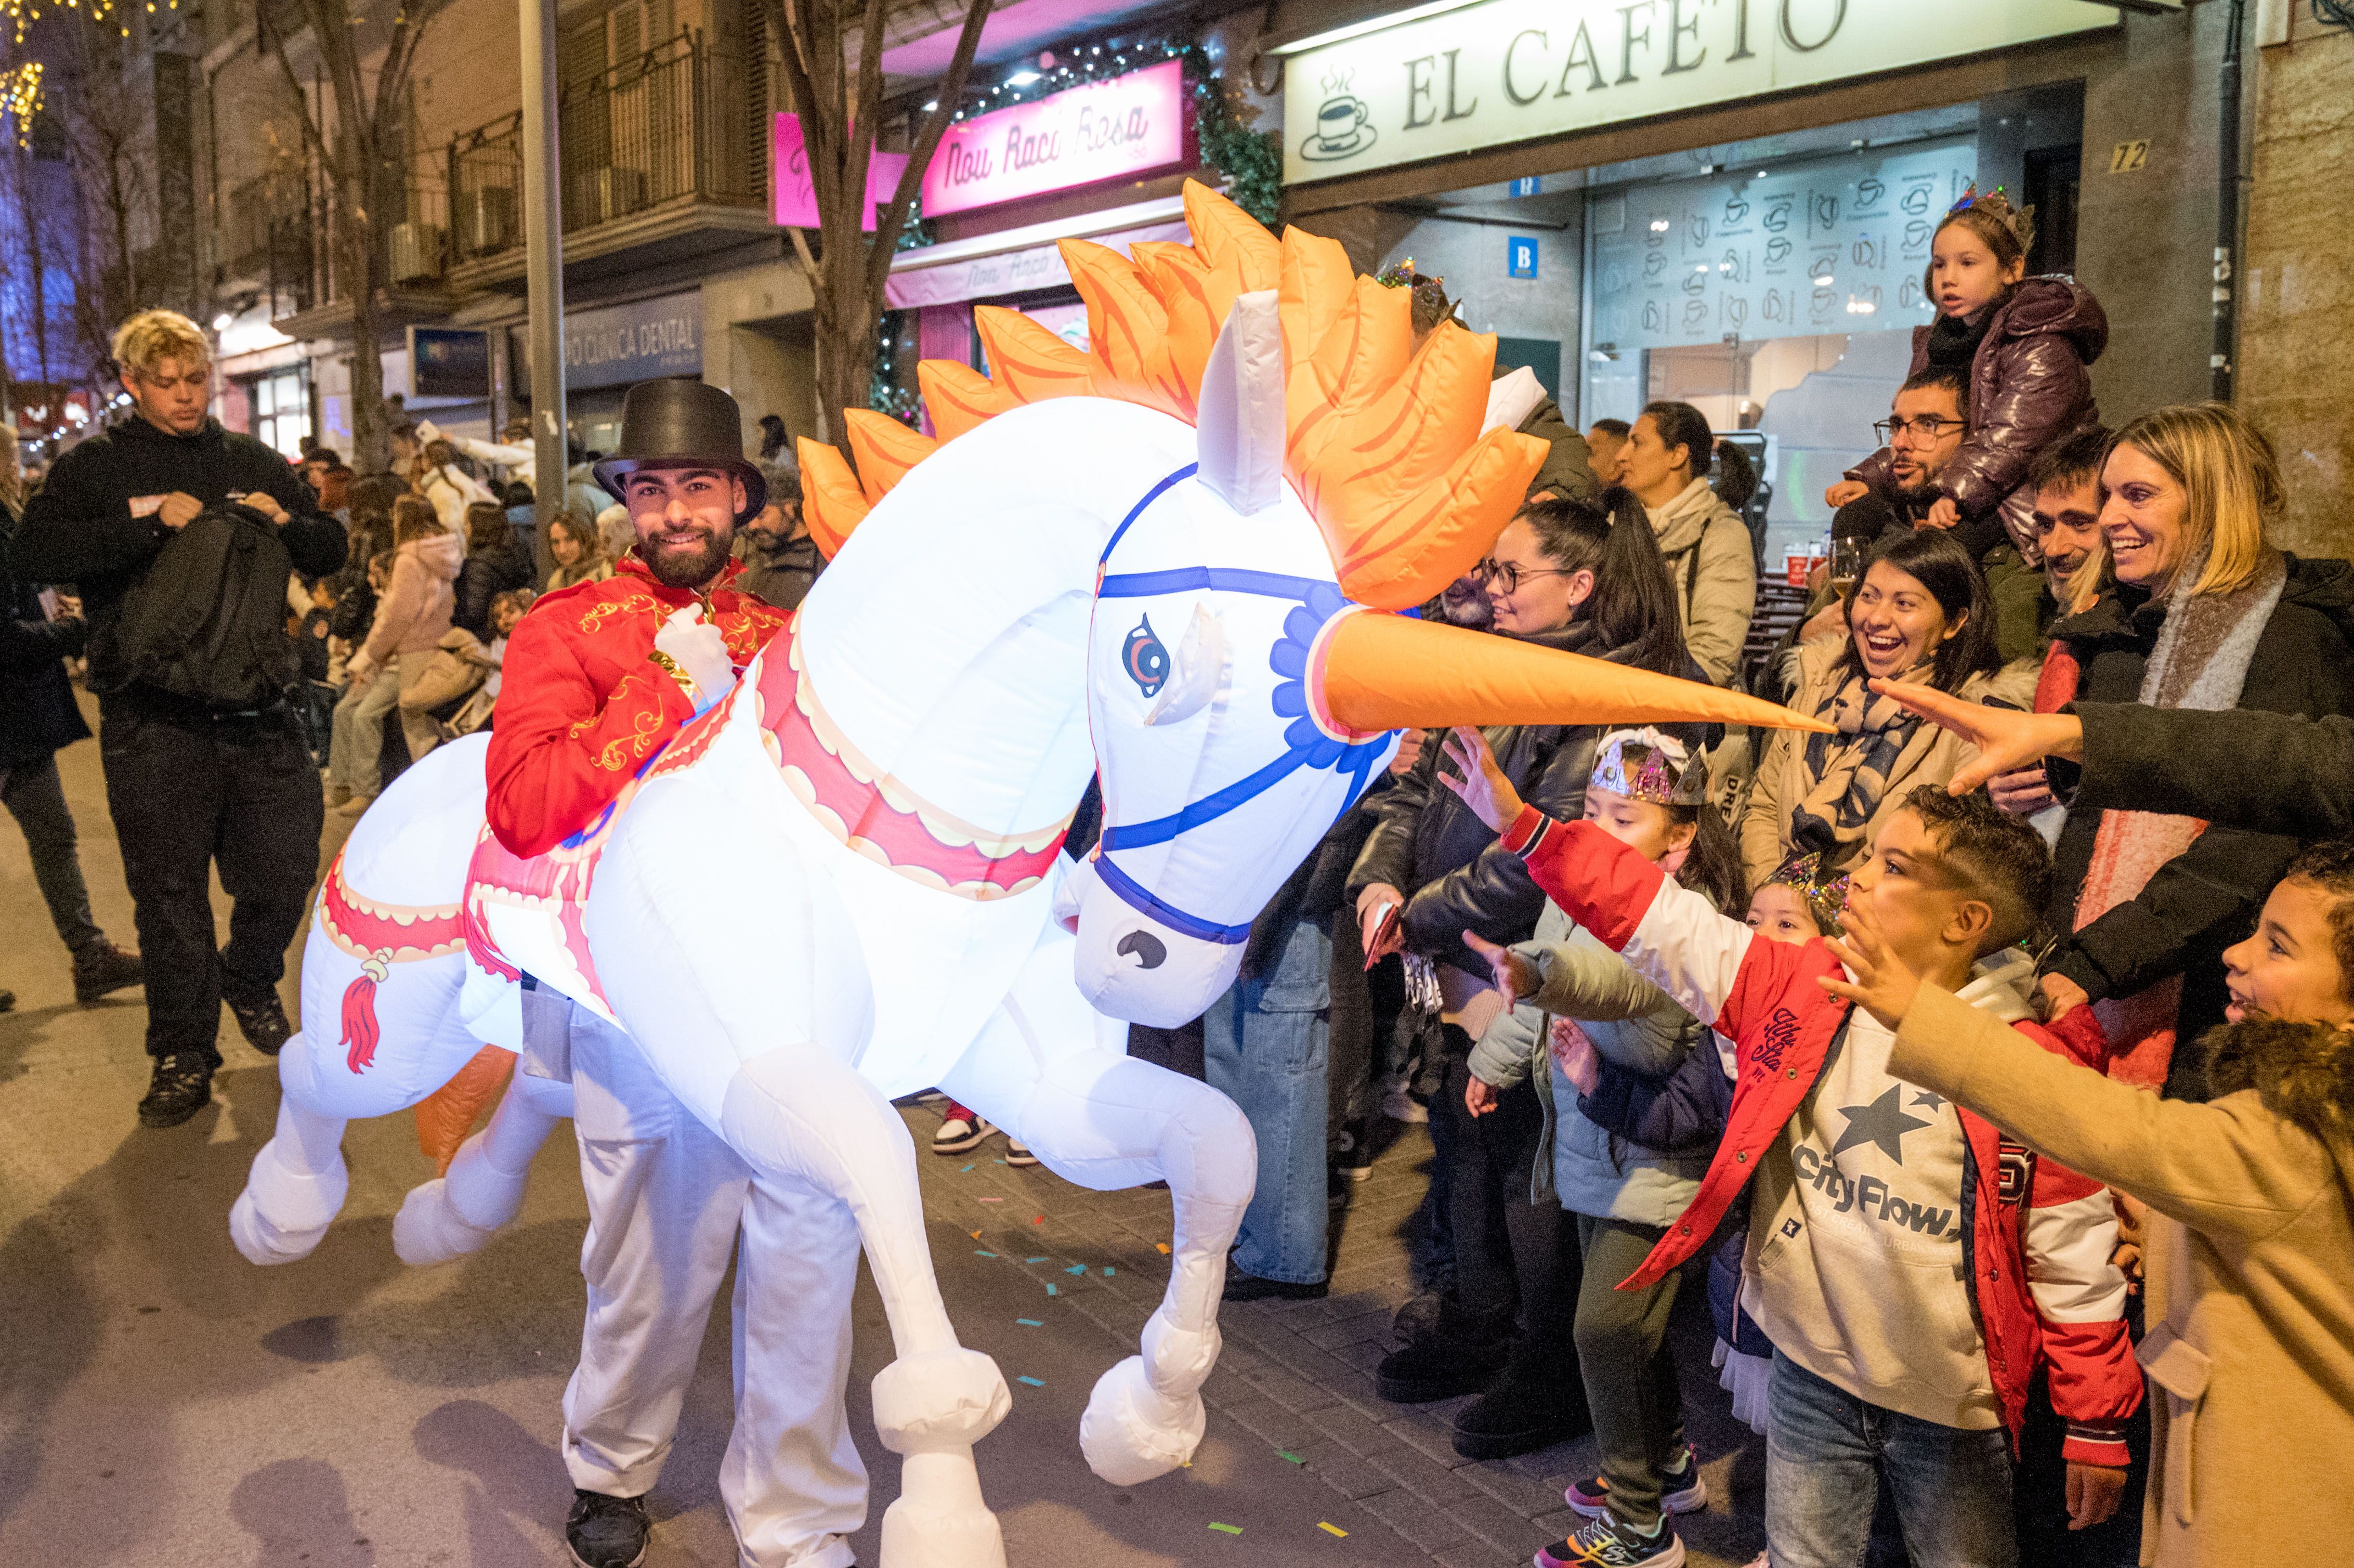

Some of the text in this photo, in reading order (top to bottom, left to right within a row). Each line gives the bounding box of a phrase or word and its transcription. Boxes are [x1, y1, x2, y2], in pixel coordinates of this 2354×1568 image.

[1402, 0, 1848, 131] EL CAFETO
[944, 141, 992, 189] Nou
[1075, 104, 1149, 155] Rosa
[1517, 245, 1531, 269] B
[640, 316, 697, 357] DENTAL
